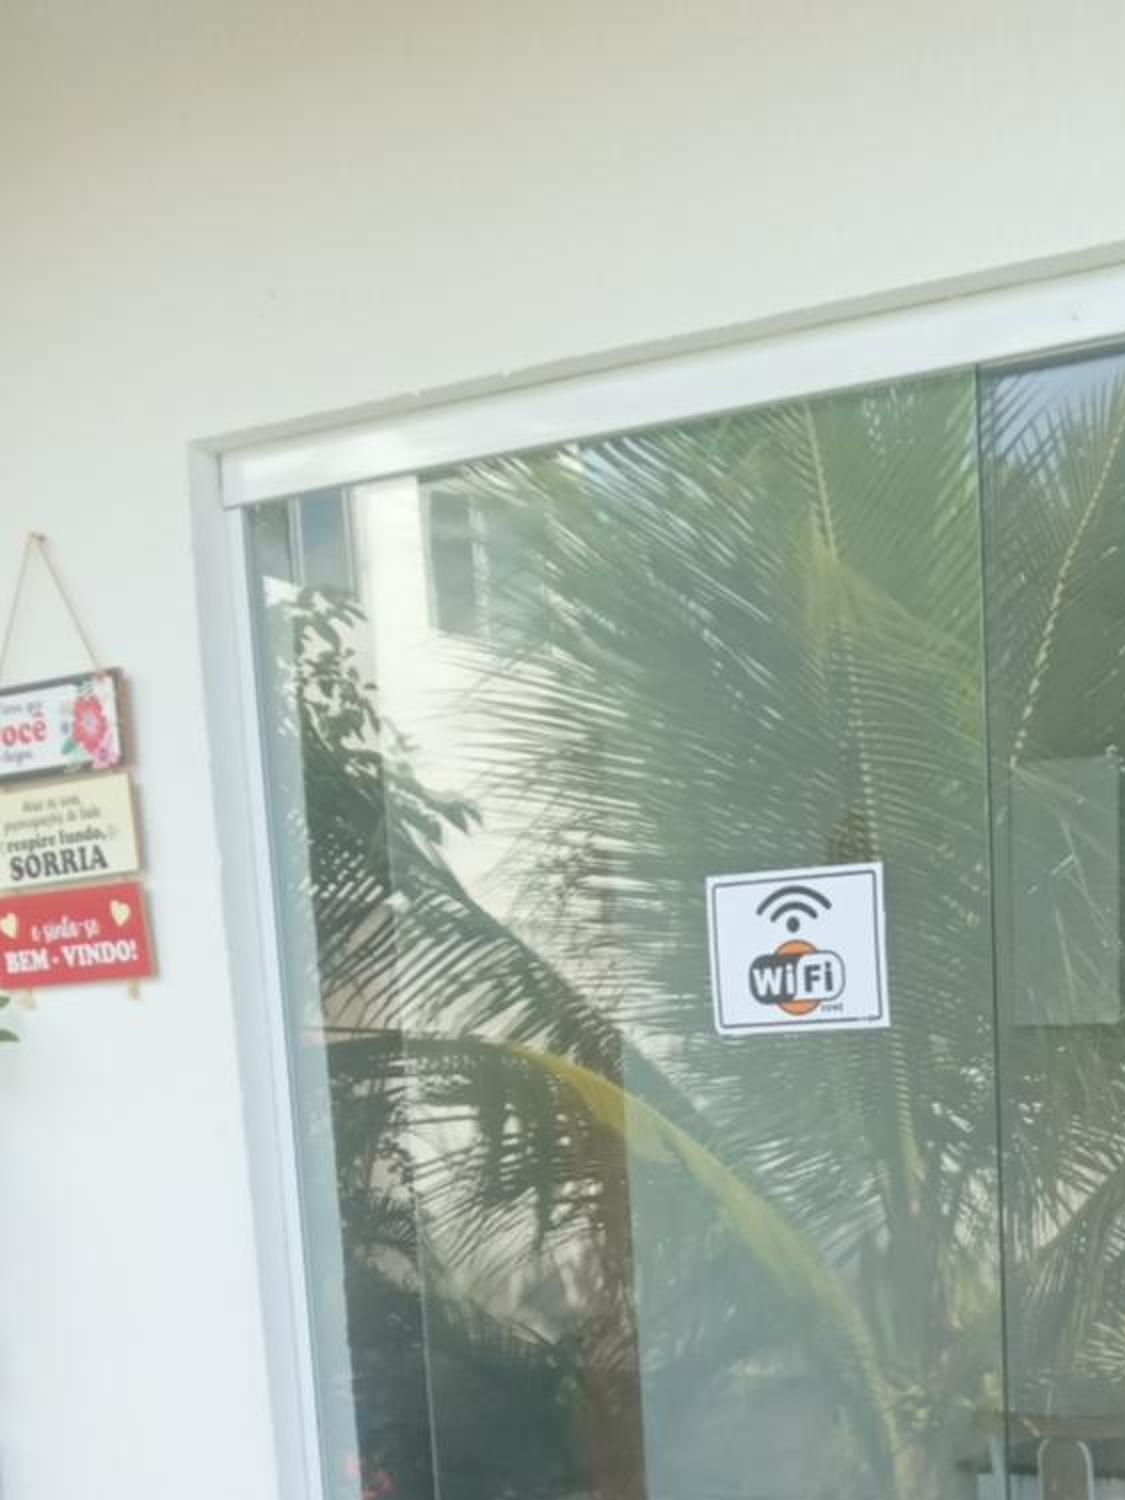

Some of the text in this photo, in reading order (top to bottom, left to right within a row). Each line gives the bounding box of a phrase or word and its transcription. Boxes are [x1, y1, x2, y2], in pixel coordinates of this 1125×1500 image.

[0, 711, 47, 748] ocê
[9, 844, 108, 881] SORRIA
[752, 962, 834, 998] WiFi
